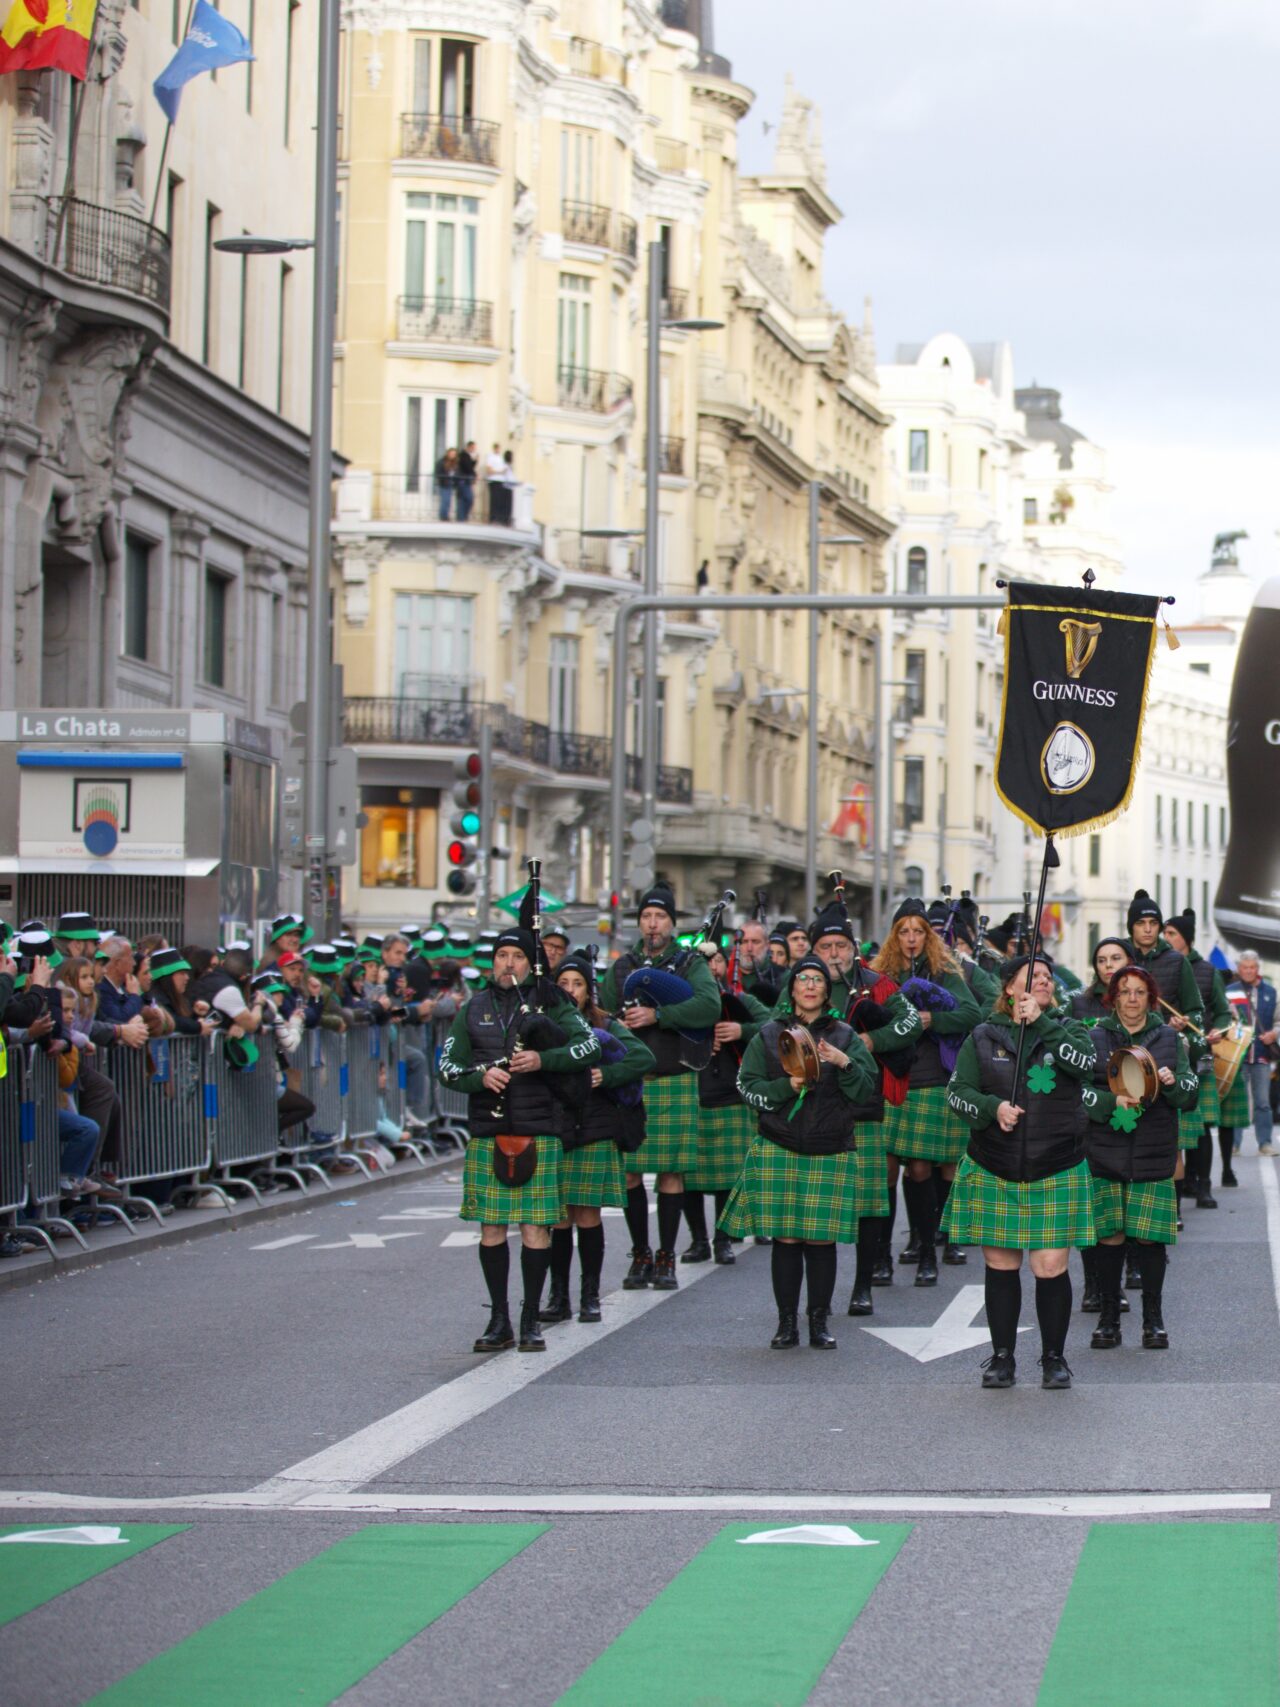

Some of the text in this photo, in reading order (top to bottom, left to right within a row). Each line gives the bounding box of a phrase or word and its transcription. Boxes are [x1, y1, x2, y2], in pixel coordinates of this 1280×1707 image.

[1033, 680, 1115, 707] GUINNESS
[22, 717, 47, 736] La
[54, 717, 120, 737] Chata
